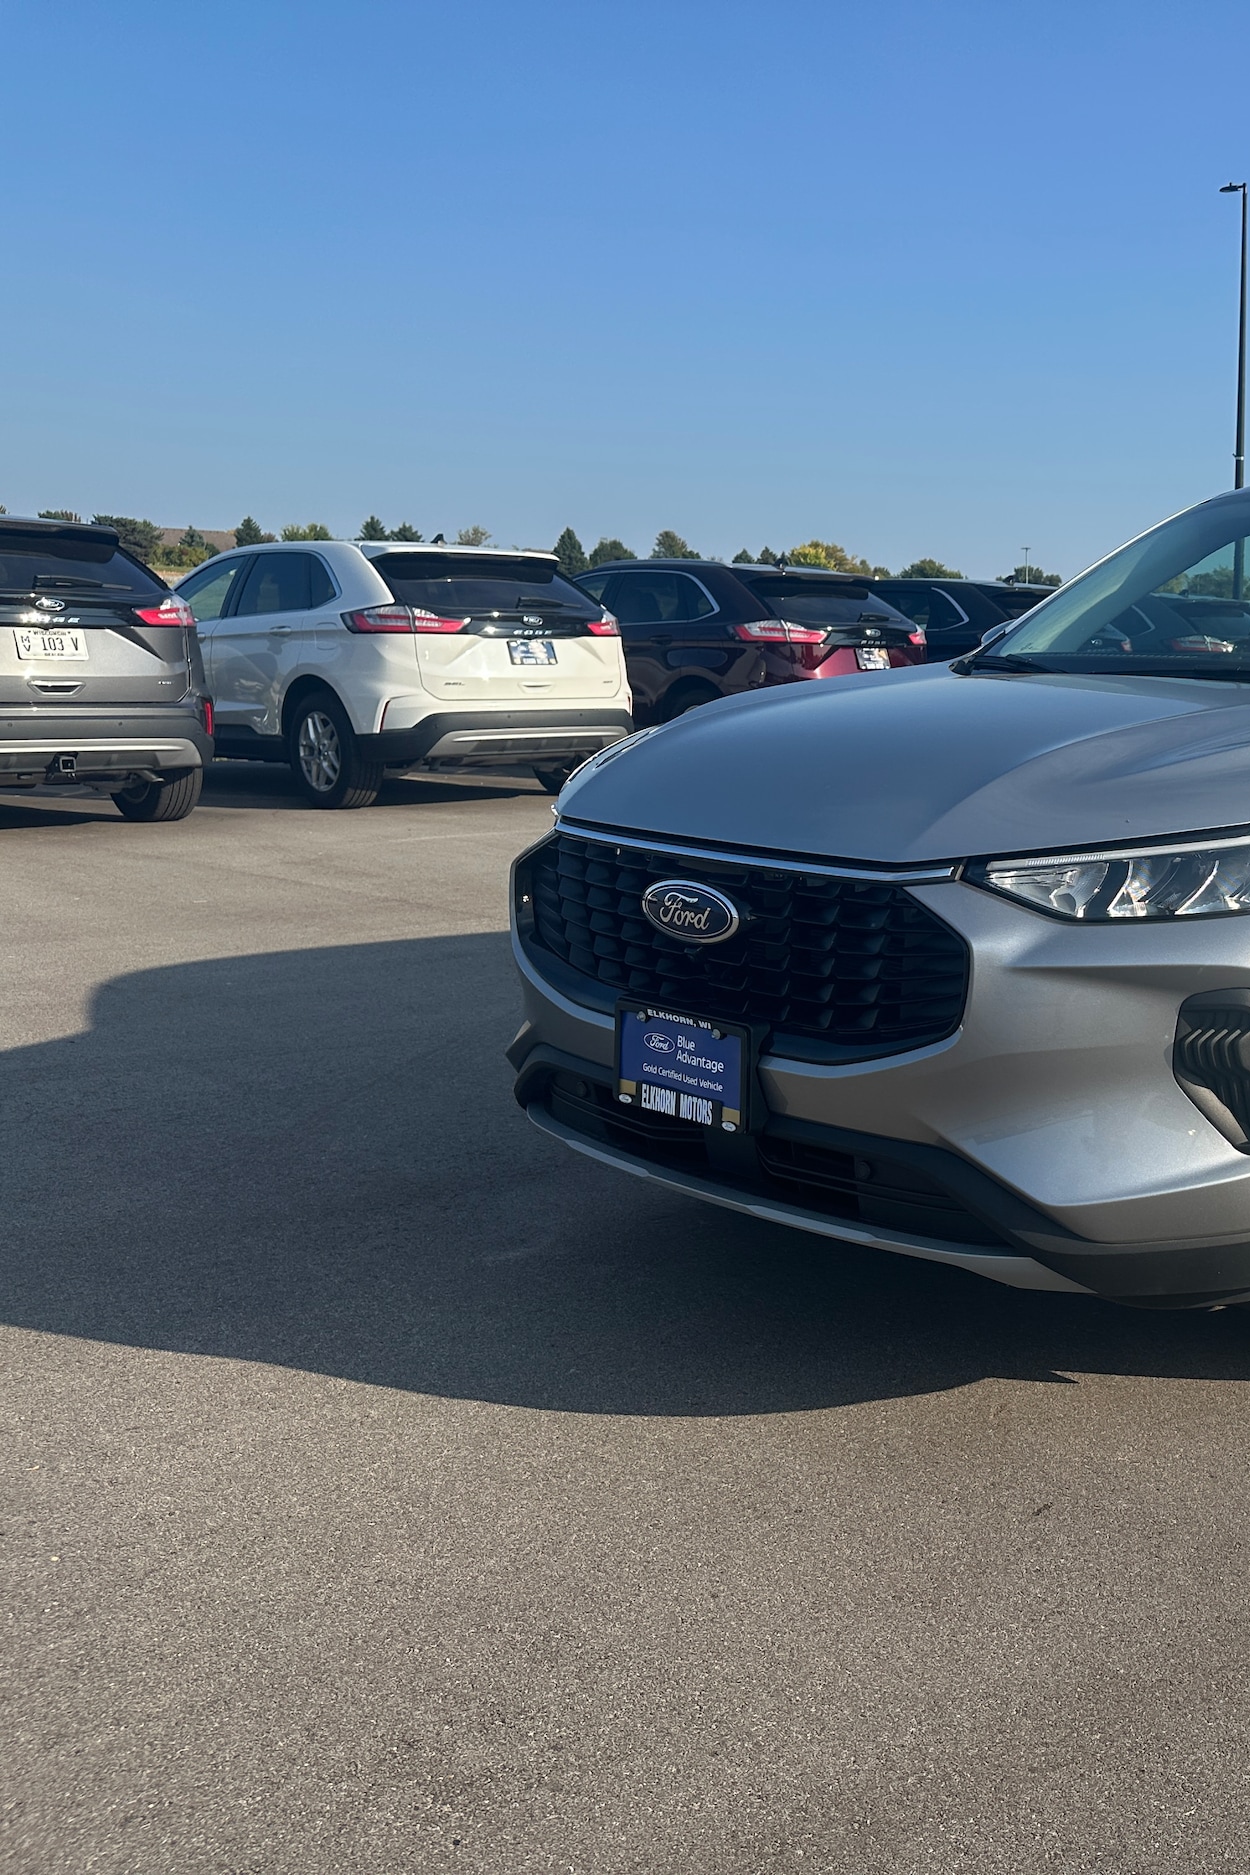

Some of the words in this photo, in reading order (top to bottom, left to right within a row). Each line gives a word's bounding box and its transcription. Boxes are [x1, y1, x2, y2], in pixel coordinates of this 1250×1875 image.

[41, 636, 65, 651] 103
[71, 637, 79, 651] V
[659, 892, 711, 930] Ford
[646, 1008, 697, 1028] ELKHORN,
[698, 1020, 711, 1030] WI
[649, 1034, 670, 1051] Ford
[677, 1035, 696, 1051] Blue
[676, 1050, 725, 1073] Advantage
[642, 1062, 657, 1074] Gold
[657, 1067, 682, 1082] Certified
[682, 1073, 698, 1086] Used
[698, 1078, 723, 1092] Vehicle
[641, 1083, 676, 1116] ELKHORN
[679, 1093, 713, 1126] MOTORS
